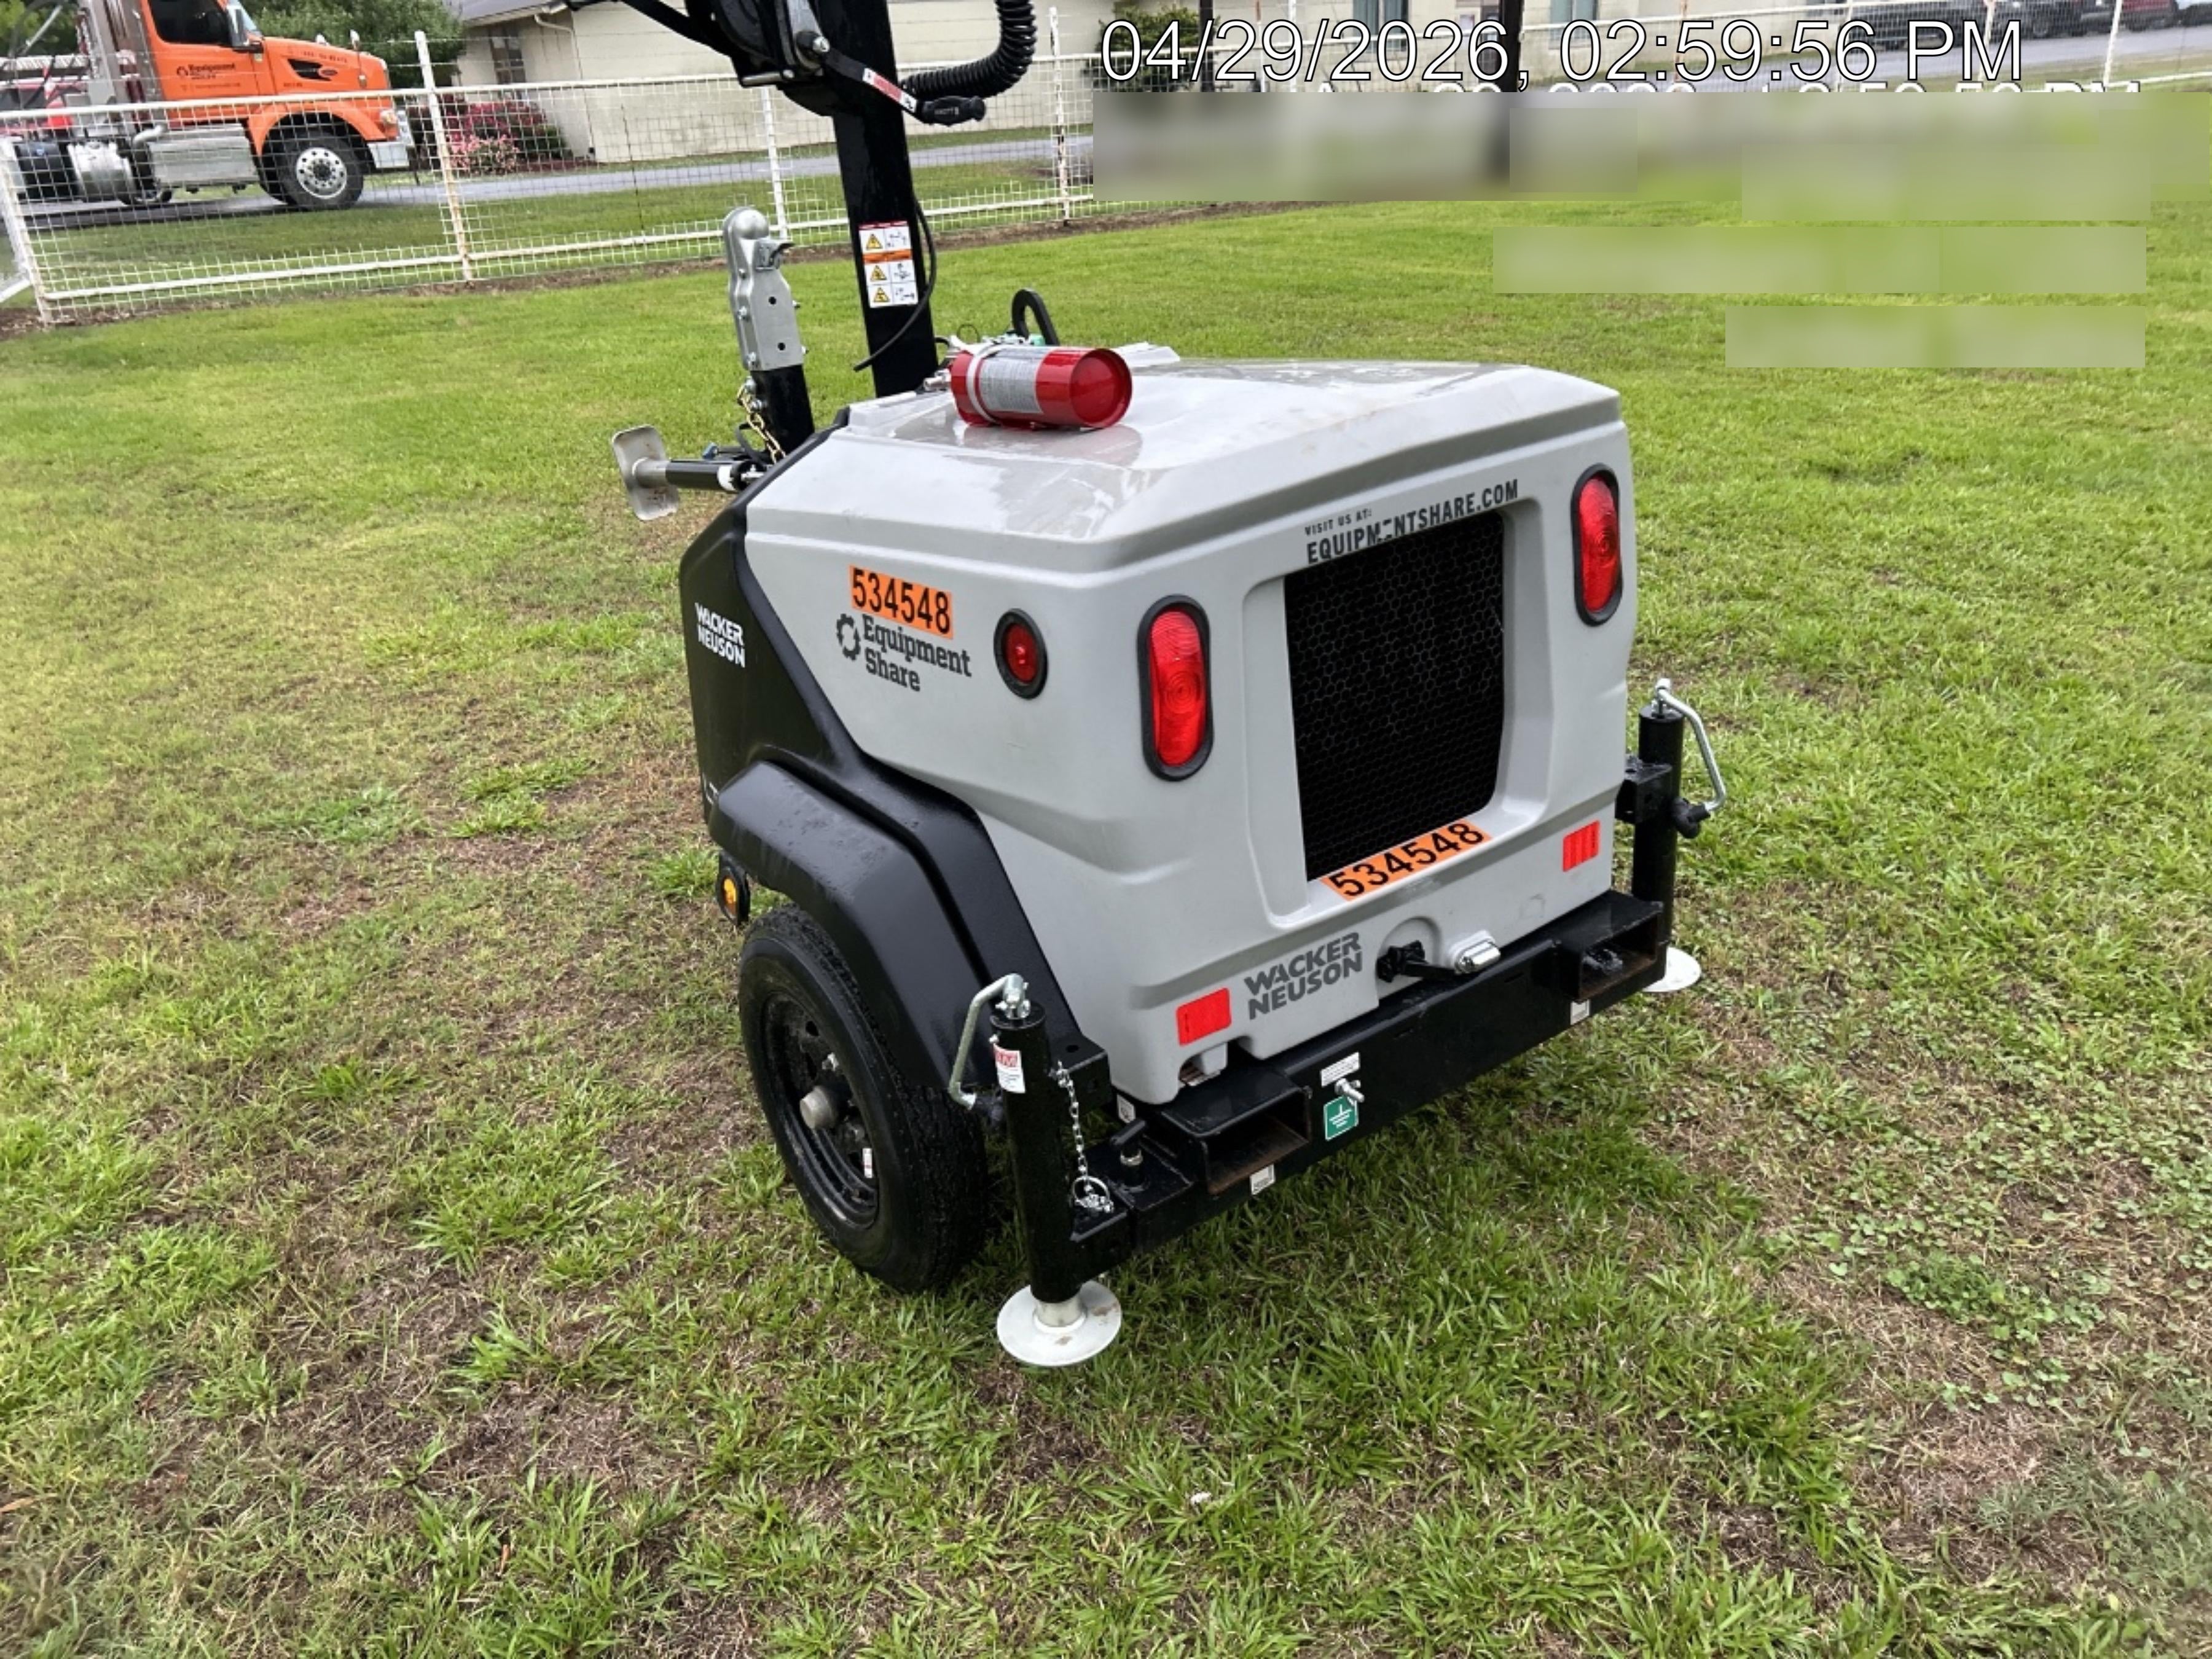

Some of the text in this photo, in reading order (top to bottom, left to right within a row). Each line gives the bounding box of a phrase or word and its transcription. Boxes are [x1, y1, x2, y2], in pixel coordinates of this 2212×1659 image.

[1305, 508, 1372, 536] VISIT US AT:
[1306, 479, 1518, 564] EQUIPMNTSHARE.COM
[694, 602, 744, 646] WACKER
[853, 567, 950, 634] 534548
[697, 623, 746, 668] NEUSON
[862, 614, 972, 677] Equipment
[865, 647, 920, 692] Share
[1328, 823, 1485, 898] 534548
[1243, 932, 1362, 995] WACKER
[1248, 952, 1363, 1020] NEUSON
